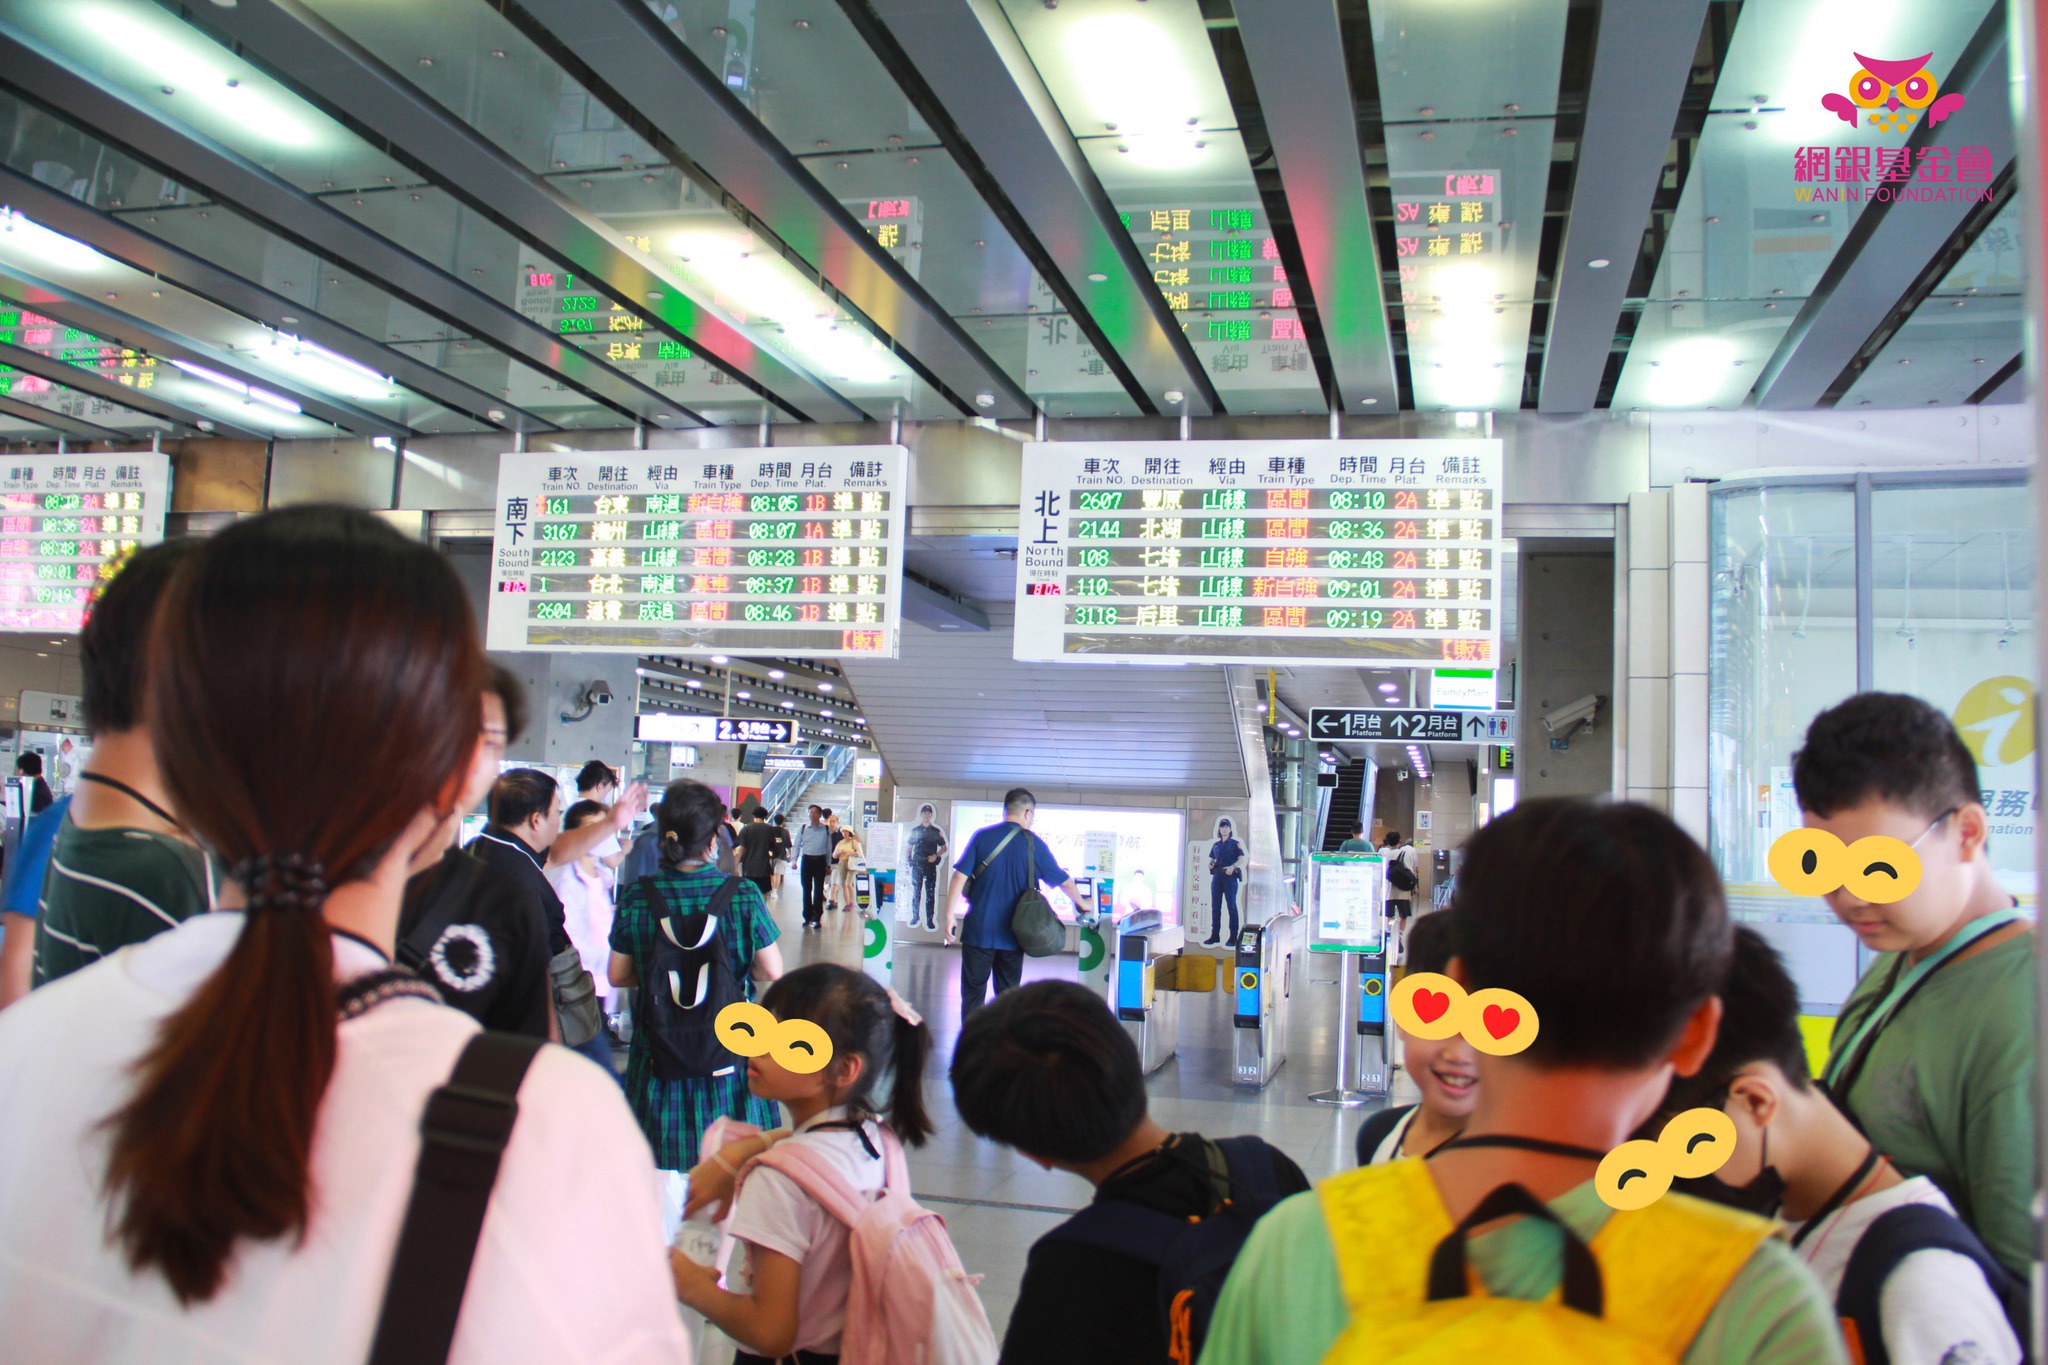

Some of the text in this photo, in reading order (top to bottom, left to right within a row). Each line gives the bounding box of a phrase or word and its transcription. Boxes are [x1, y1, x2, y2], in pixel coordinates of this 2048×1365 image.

[53, 466, 77, 479] 時間
[83, 466, 106, 479] 月台
[549, 461, 883, 481] 車次 開往 經由 車種 時間 月台 備註
[1084, 456, 1480, 475] 車次 開往 經由 車種 時間 月台 備註
[542, 483, 564, 491] Train
[588, 483, 638, 491] Destination
[694, 481, 716, 489] Train
[720, 481, 741, 490] Type
[751, 480, 771, 489] Dep.
[844, 479, 887, 487] Remarks
[1076, 474, 1486, 485] Train NO. Destination Via Train Type Dep. Time Plat. Remarks
[83, 494, 99, 509] 2A
[546, 499, 569, 513] 161
[594, 496, 629, 514] 台東
[751, 495, 798, 511] 08:05
[806, 495, 825, 511] 1B
[1080, 492, 1122, 510] 2607
[1141, 490, 1183, 511] 豐原
[1203, 489, 1246, 510] 山線
[1266, 489, 1309, 509] 區間
[1330, 492, 1385, 509] 08:10
[1395, 492, 1417, 509] 2A
[80, 518, 97, 532] 2A
[506, 497, 528, 545] 南下
[1033, 490, 1060, 543] 北上
[543, 525, 577, 539] 3167
[643, 521, 679, 540] 山線
[695, 520, 732, 539] 區間
[749, 523, 796, 539] 08:07
[805, 523, 824, 539] 1A
[1079, 521, 1120, 538] 2144
[1140, 519, 1183, 539] 北湖
[1202, 519, 1245, 539] 山線
[1266, 518, 1309, 538] 區間
[1329, 521, 1384, 538] 08:36
[1395, 521, 1417, 538] 2A
[500, 549, 530, 557] South
[541, 551, 575, 566] 2123
[642, 548, 678, 567] 山線
[693, 548, 731, 567] 區間
[748, 550, 795, 566] 08:28
[803, 549, 823, 566] 1B
[1026, 547, 1063, 556] North
[1079, 550, 1109, 567] 108
[1139, 547, 1181, 568] 七堵
[1201, 547, 1244, 568] 山線
[1265, 548, 1309, 568] 自強
[1328, 551, 1384, 569] 08:48
[1393, 551, 1416, 569] 2A
[499, 559, 529, 567] Bound
[1026, 557, 1063, 567] Bound
[540, 577, 547, 592] 1
[589, 574, 623, 593] 台北
[746, 577, 793, 593] 08:37
[802, 577, 821, 594] 1B
[1078, 578, 1108, 595] 110
[1138, 576, 1180, 597] 七堵
[1200, 577, 1243, 597] 山線
[1253, 577, 1318, 598] 新自強
[1328, 580, 1381, 598] 09:01
[1393, 580, 1416, 598] 2A
[537, 603, 571, 618] 2604
[691, 602, 727, 620] 區間
[745, 605, 792, 620] 08:46
[801, 605, 820, 620] 1B
[1075, 607, 1117, 624] 3118
[1137, 605, 1178, 626] 后里
[1199, 606, 1242, 626] 山線
[1263, 607, 1307, 627] 區間
[1327, 610, 1382, 628] 09:19
[1392, 610, 1416, 629] 2A
[1436, 688, 1489, 697] FamilyMart
